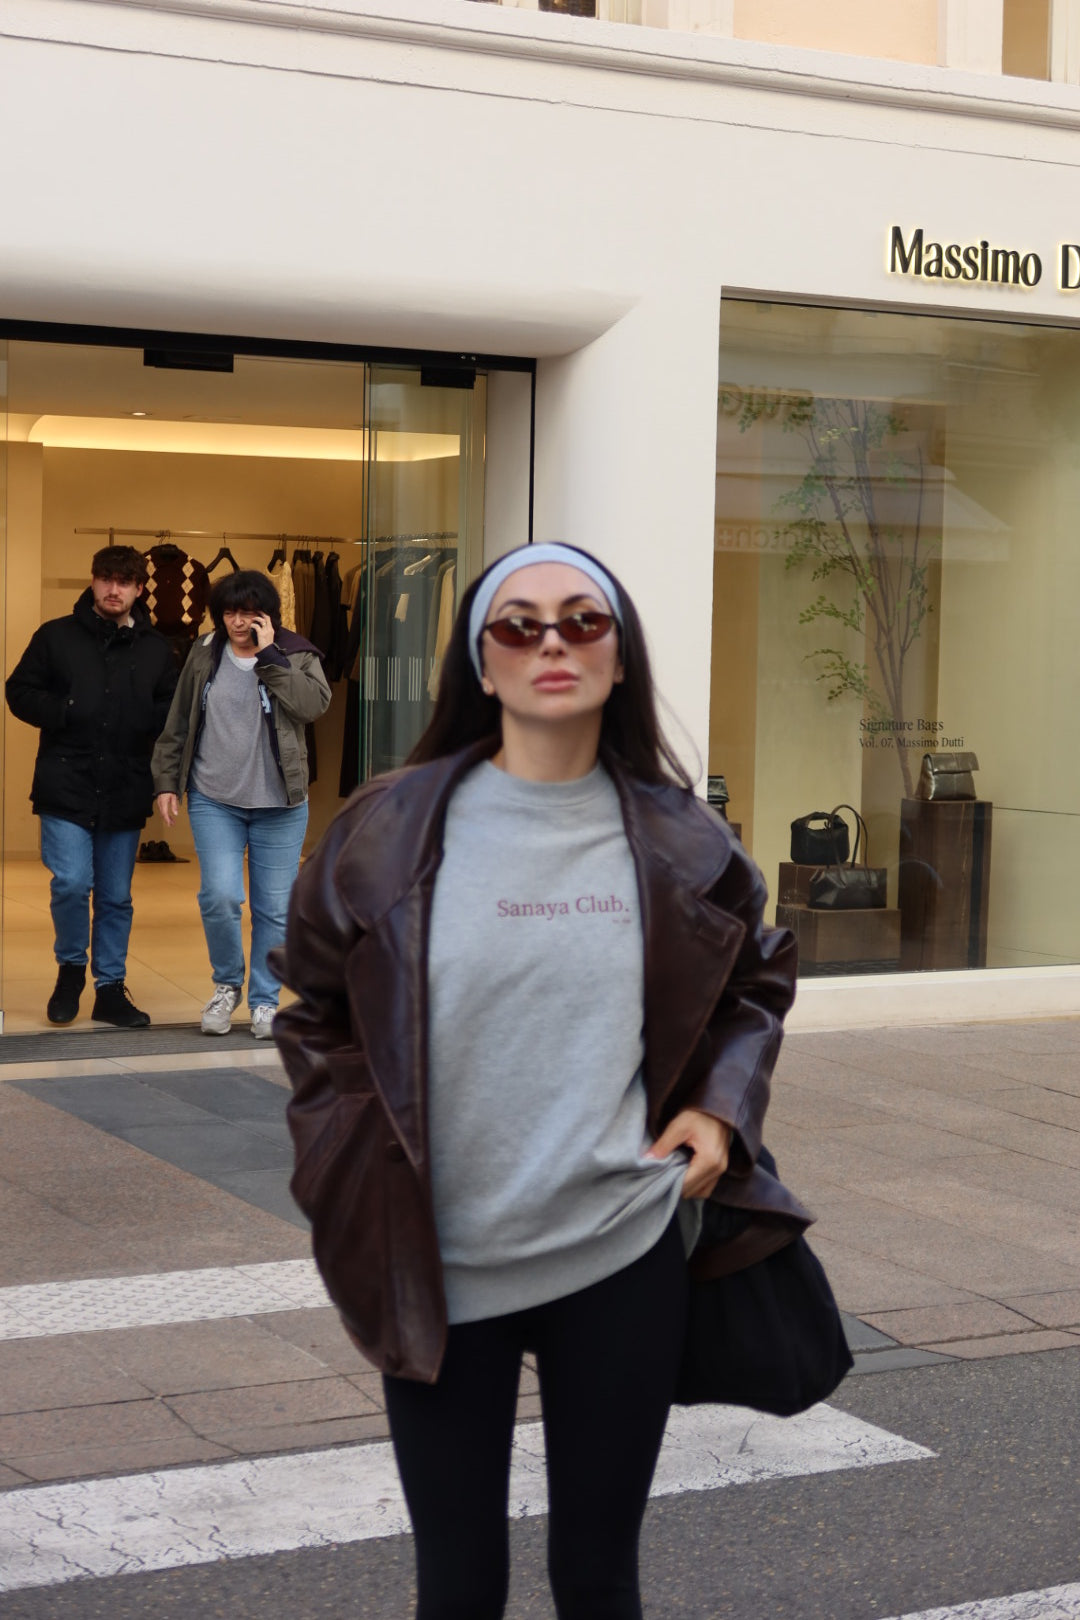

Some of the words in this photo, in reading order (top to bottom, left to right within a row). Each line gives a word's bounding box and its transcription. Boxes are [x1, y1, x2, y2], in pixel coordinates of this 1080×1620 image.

[890, 226, 1042, 287] Massimo
[859, 718, 914, 733] Signature
[917, 719, 944, 733] Bags
[859, 738, 878, 748] Vol.
[897, 737, 939, 748] Massimo
[941, 737, 964, 748] Dutti
[497, 899, 570, 920] Sanaya
[576, 895, 629, 913] Club.
